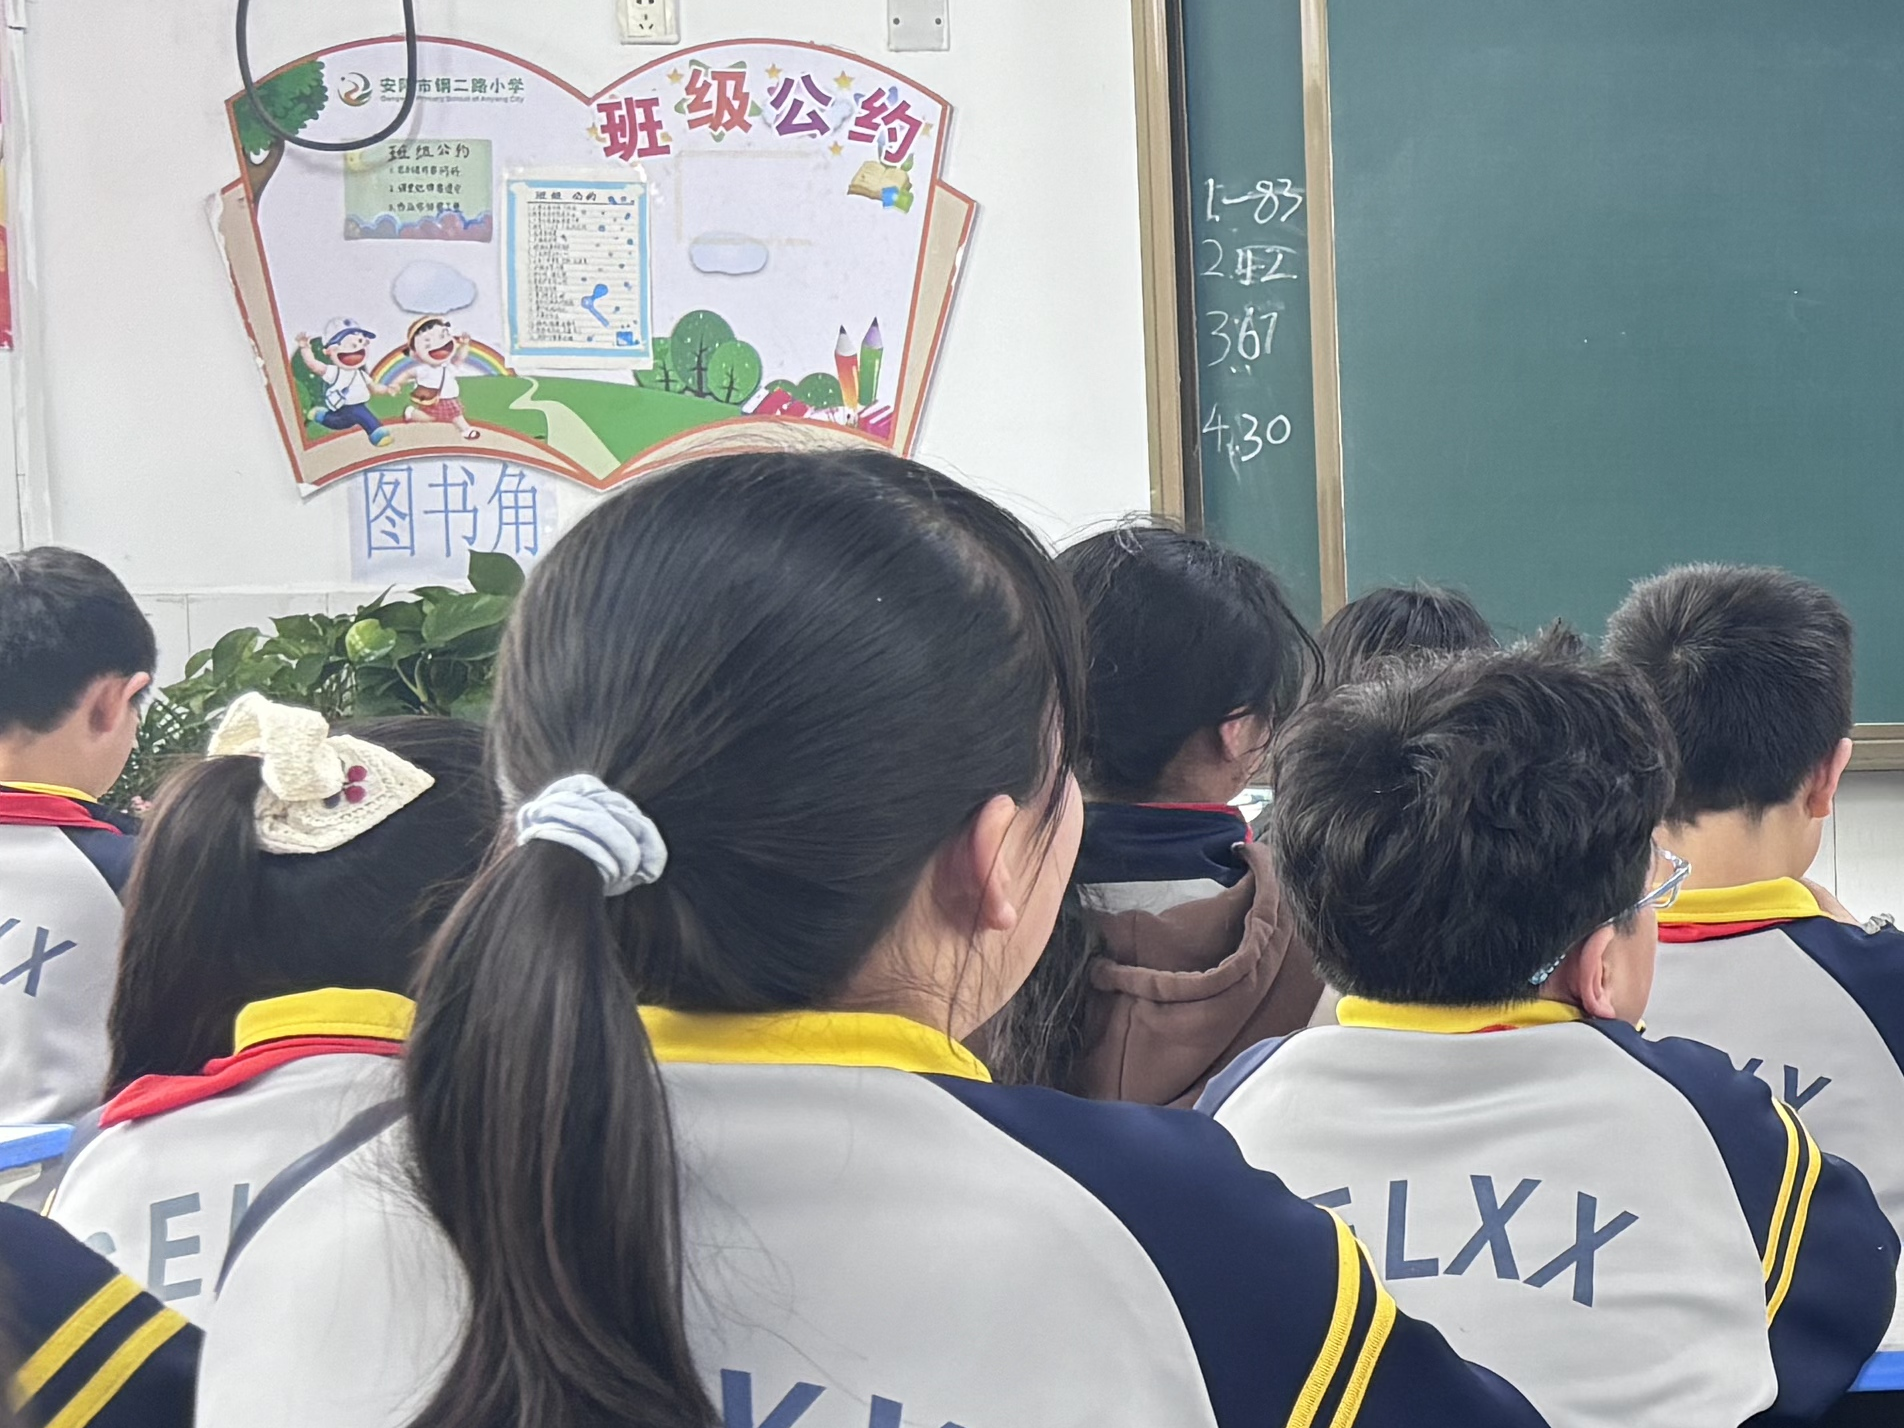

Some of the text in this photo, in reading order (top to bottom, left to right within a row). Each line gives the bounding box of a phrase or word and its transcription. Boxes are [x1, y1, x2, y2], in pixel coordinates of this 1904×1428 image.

[595, 66, 925, 166] 班级公约
[361, 460, 541, 559] 图书角
